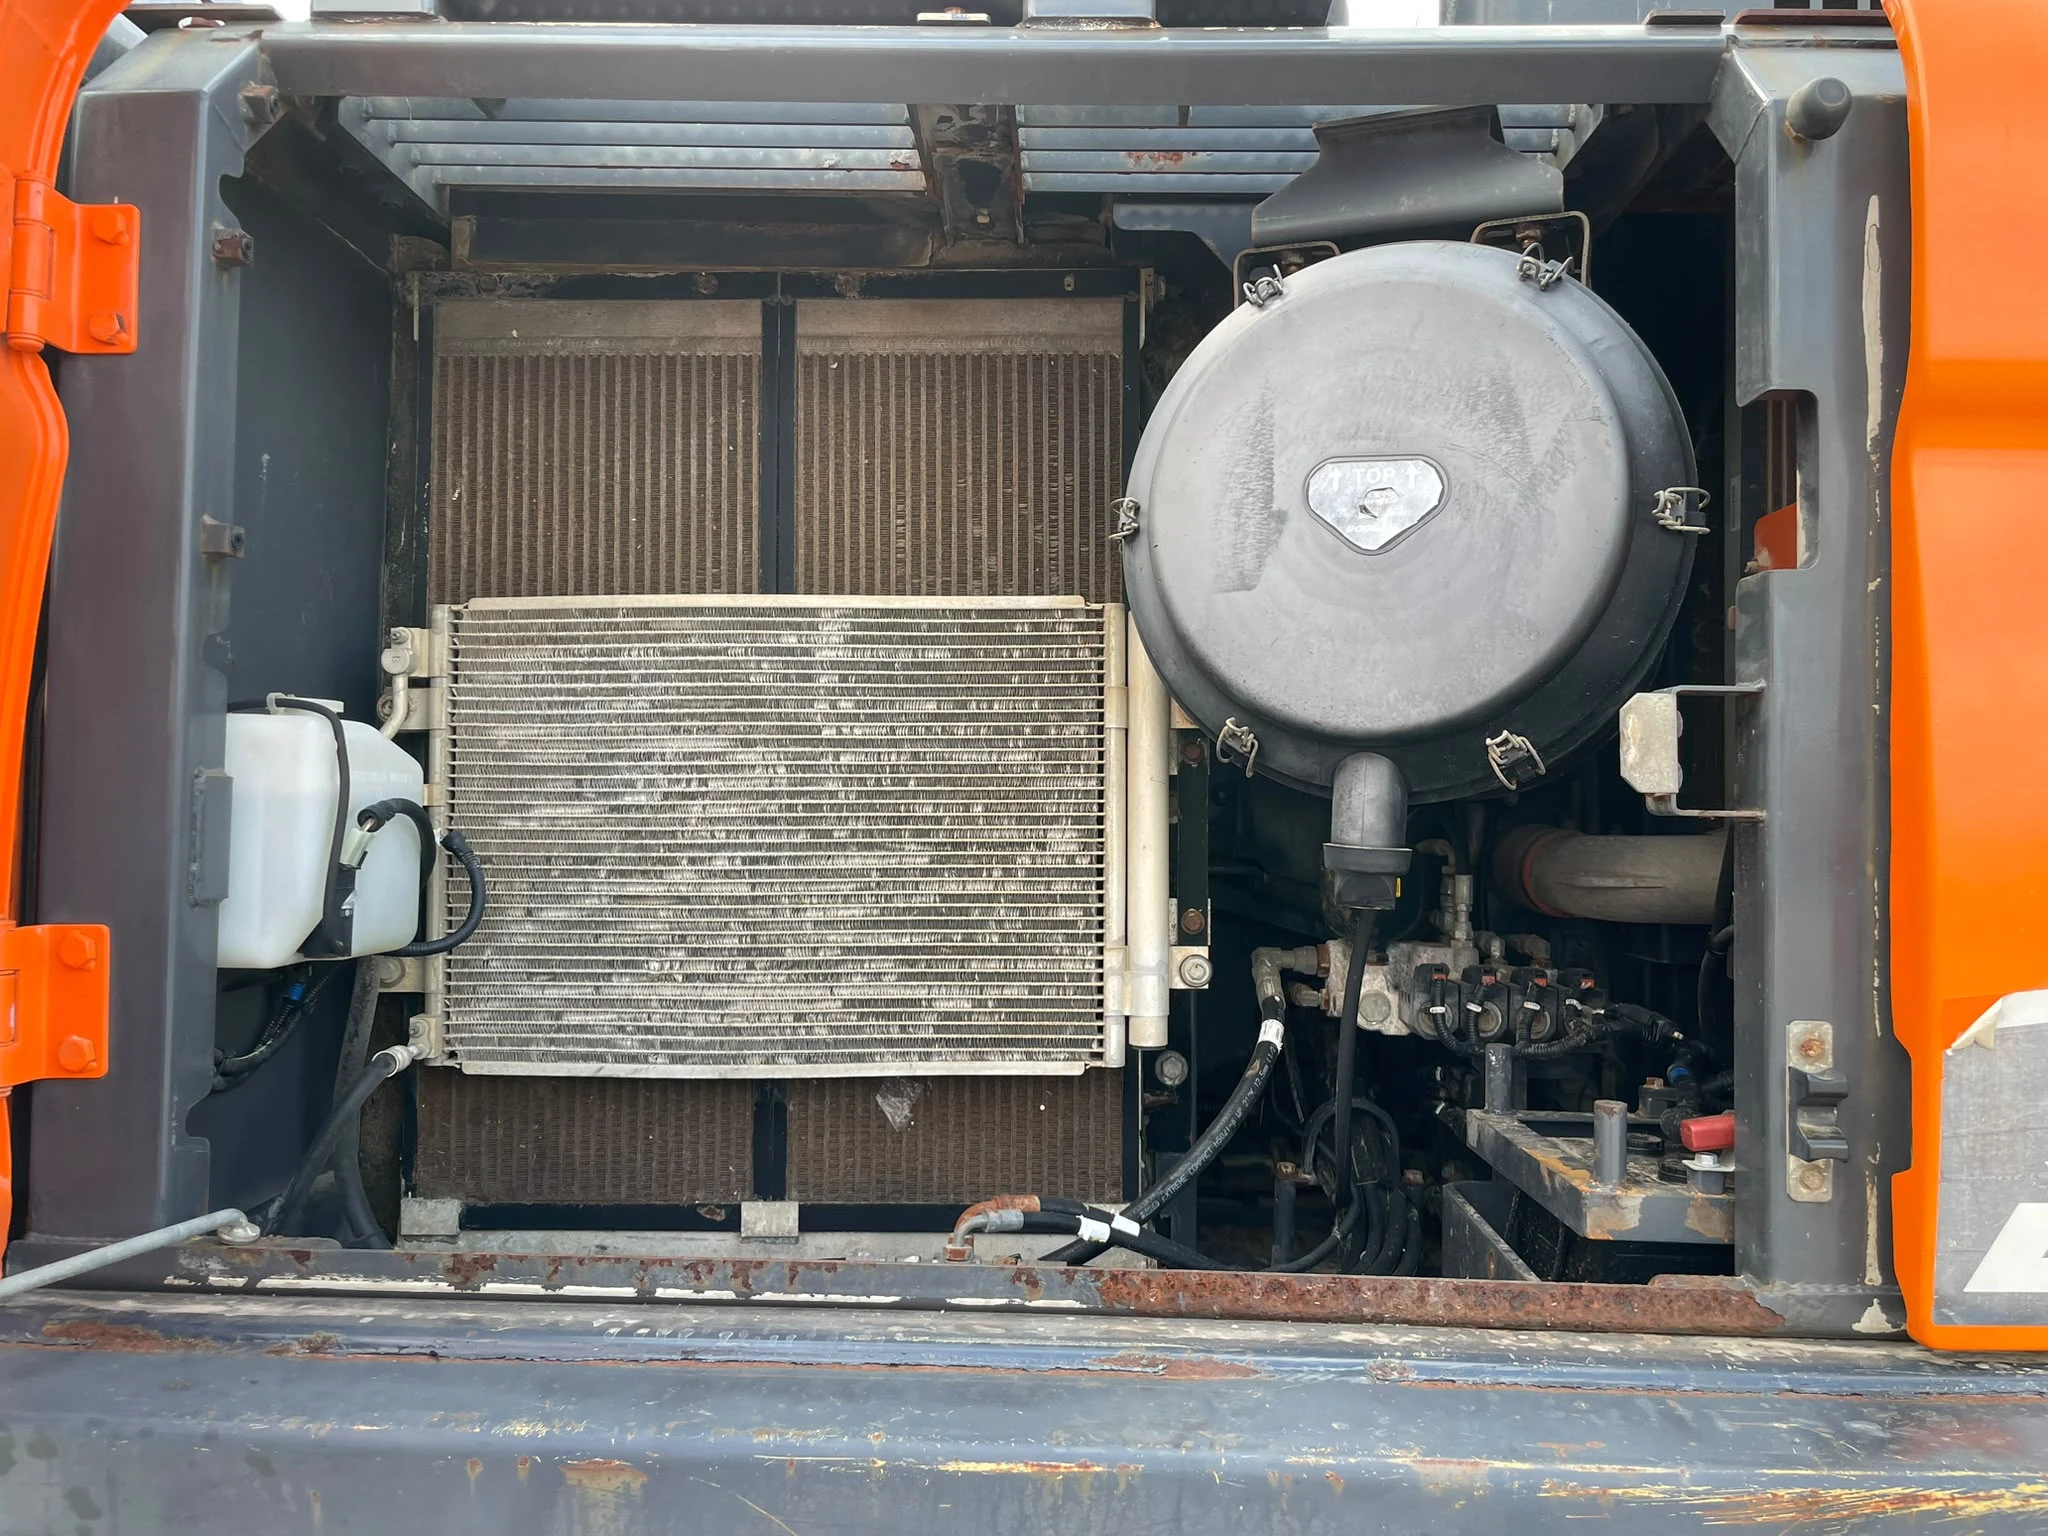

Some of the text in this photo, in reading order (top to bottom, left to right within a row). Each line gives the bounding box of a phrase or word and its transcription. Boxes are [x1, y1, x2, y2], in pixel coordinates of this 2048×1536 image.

[1352, 466, 1395, 484] TOP
[1161, 1173, 1188, 1202] EXTREME
[1188, 1146, 1213, 1175] COMPACT
